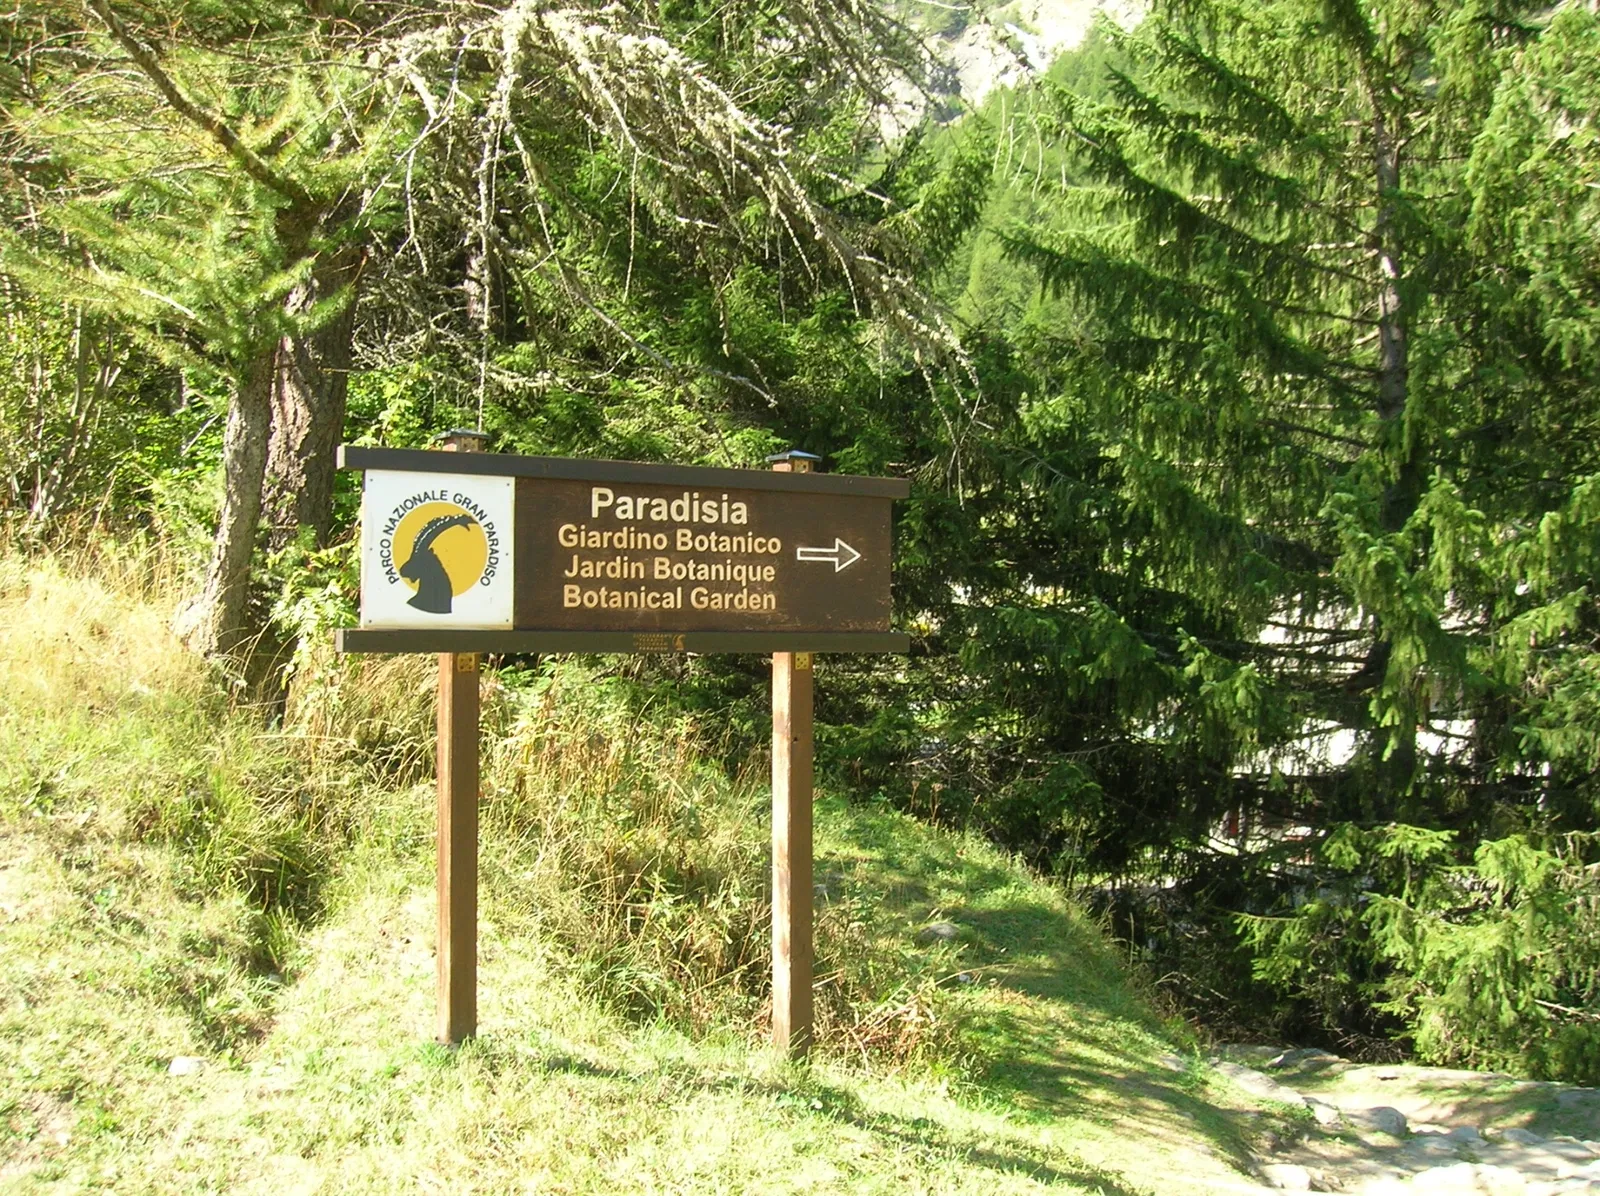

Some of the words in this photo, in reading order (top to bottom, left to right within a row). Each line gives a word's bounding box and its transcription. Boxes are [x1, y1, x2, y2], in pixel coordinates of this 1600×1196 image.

[383, 490, 448, 536] NAZIONALE
[453, 493, 488, 521] GRAN
[591, 487, 748, 525] Paradisia
[480, 522, 499, 587] PARADISO
[558, 524, 668, 550] Giardino
[676, 528, 782, 554] Botanico
[380, 538, 400, 585] PARCO
[564, 554, 645, 579] Jardin
[654, 557, 776, 587] Botanique
[563, 584, 682, 609] Botanical
[690, 587, 776, 610] Garden
